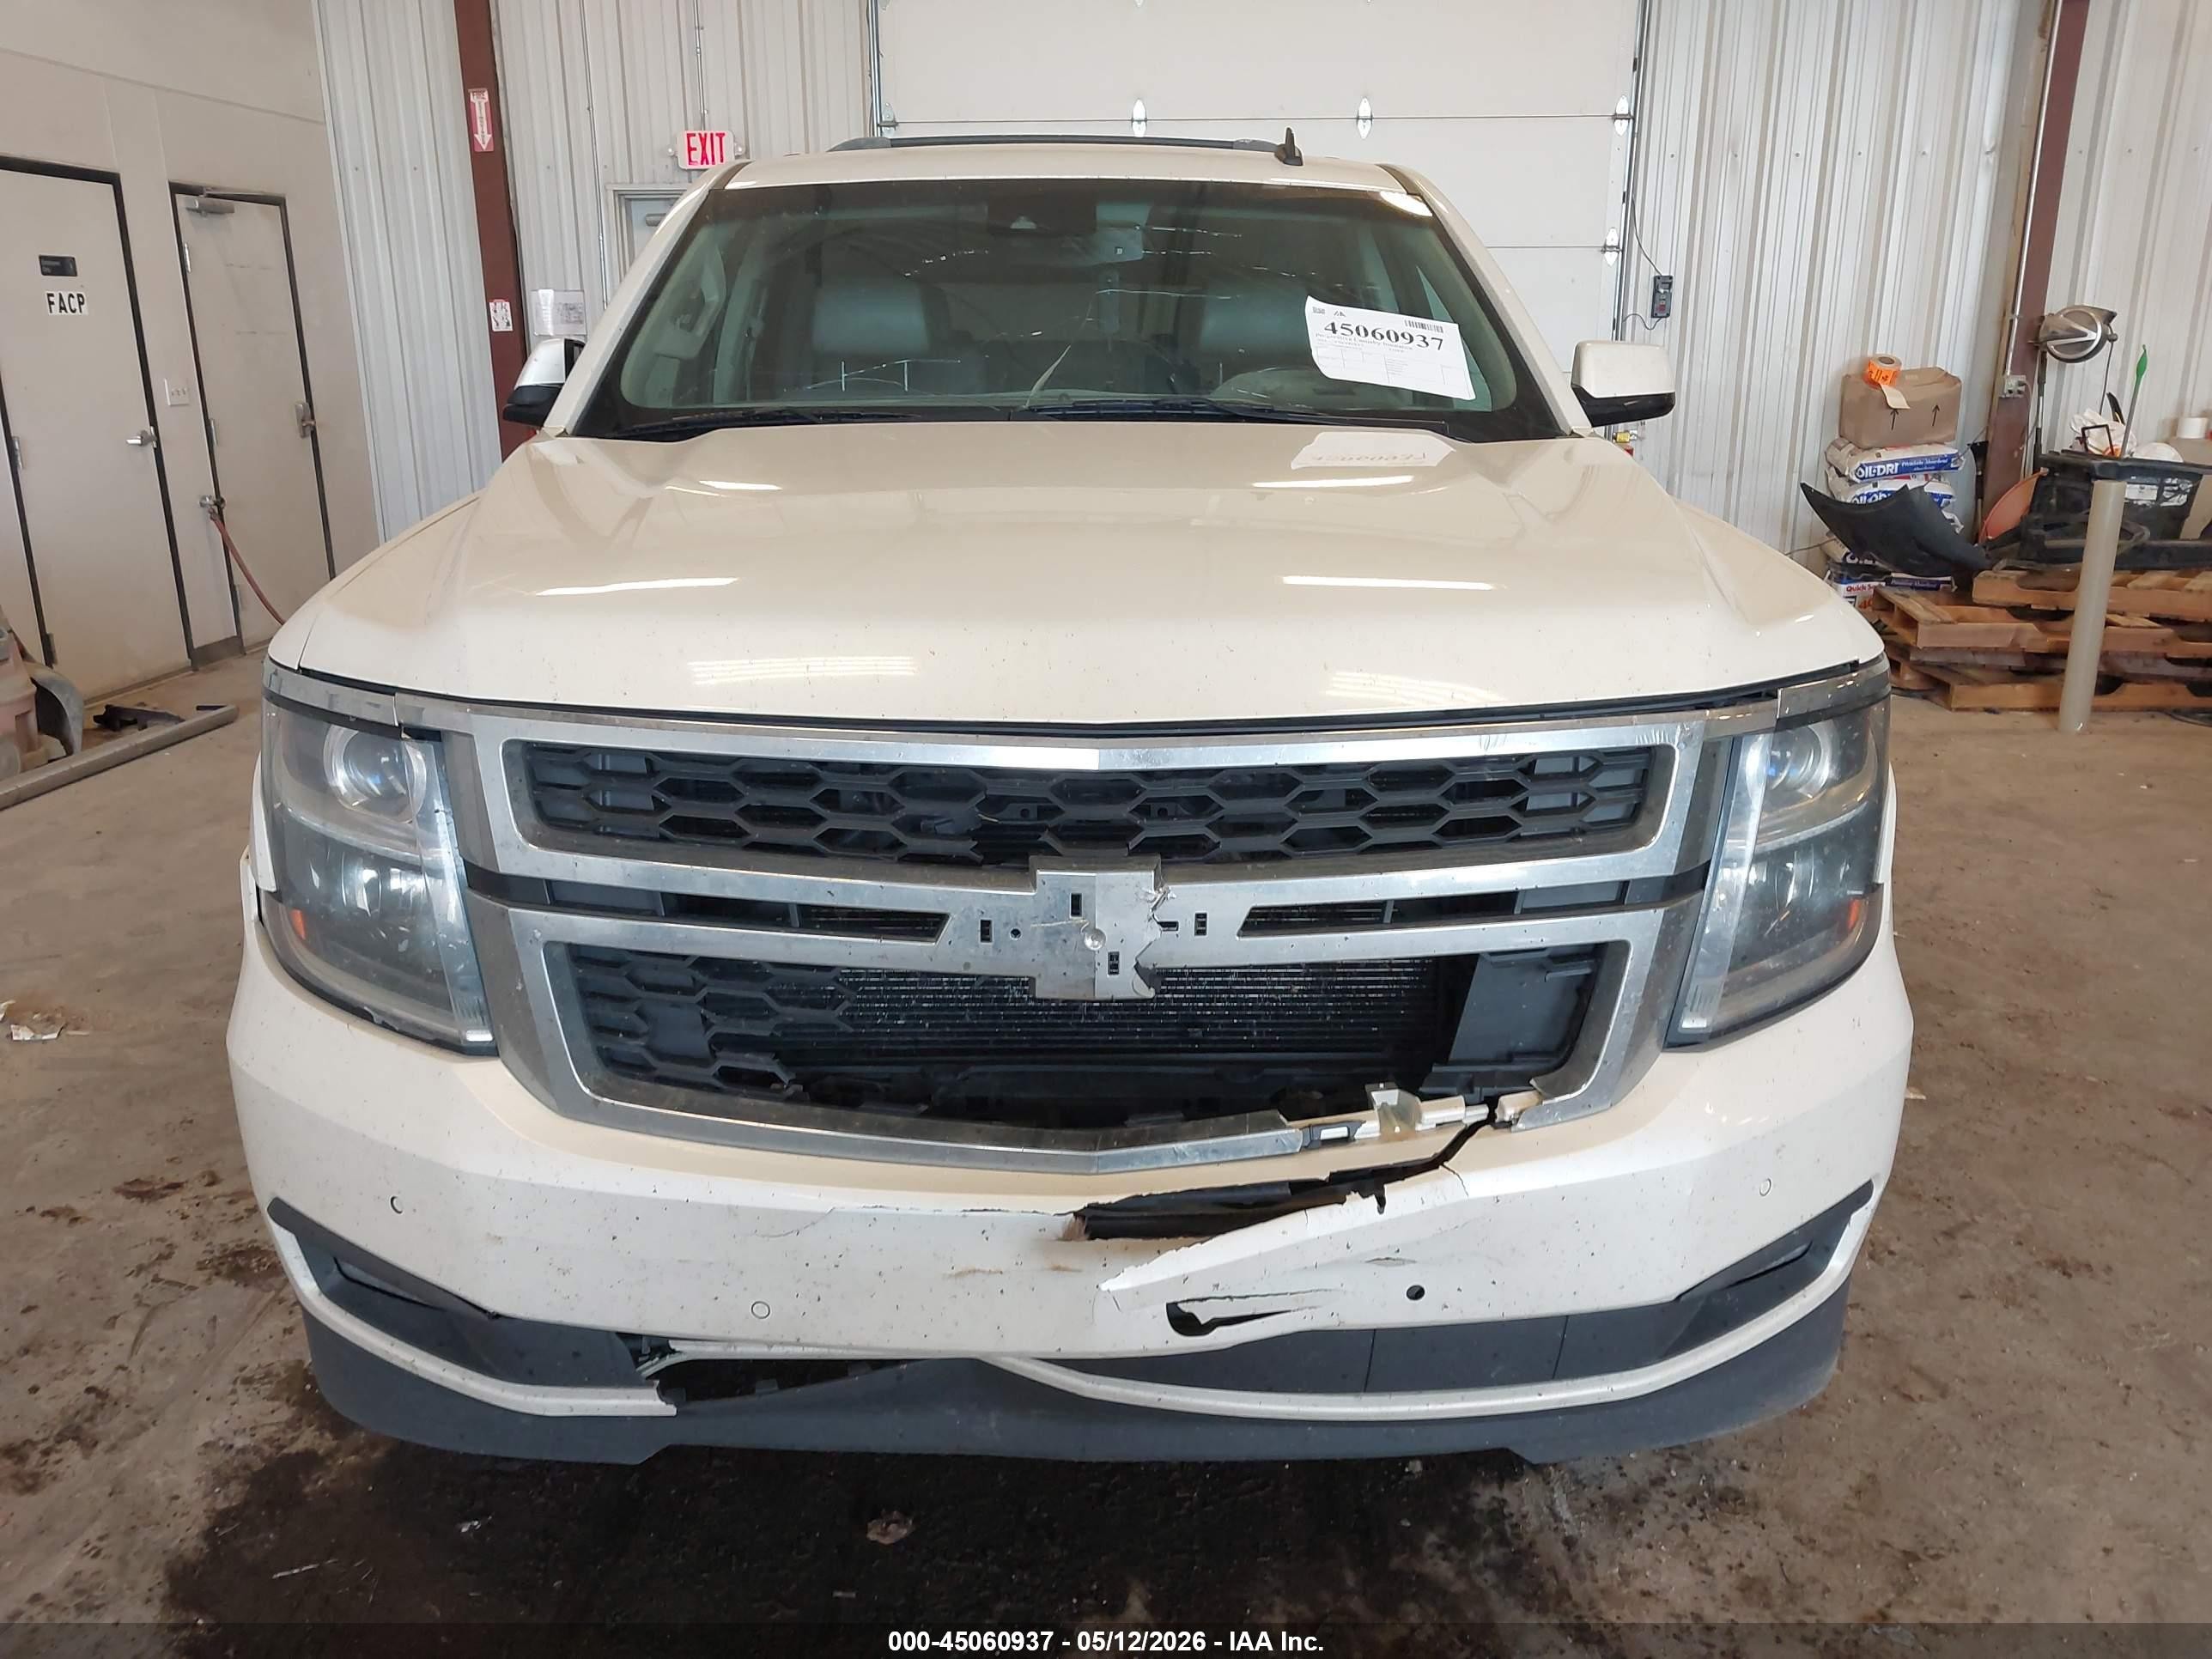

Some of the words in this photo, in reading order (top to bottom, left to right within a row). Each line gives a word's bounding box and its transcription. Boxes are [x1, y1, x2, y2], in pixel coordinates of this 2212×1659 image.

[686, 132, 726, 166] EXIT
[46, 292, 85, 314] FACP
[1323, 320, 1443, 351] 45060937
